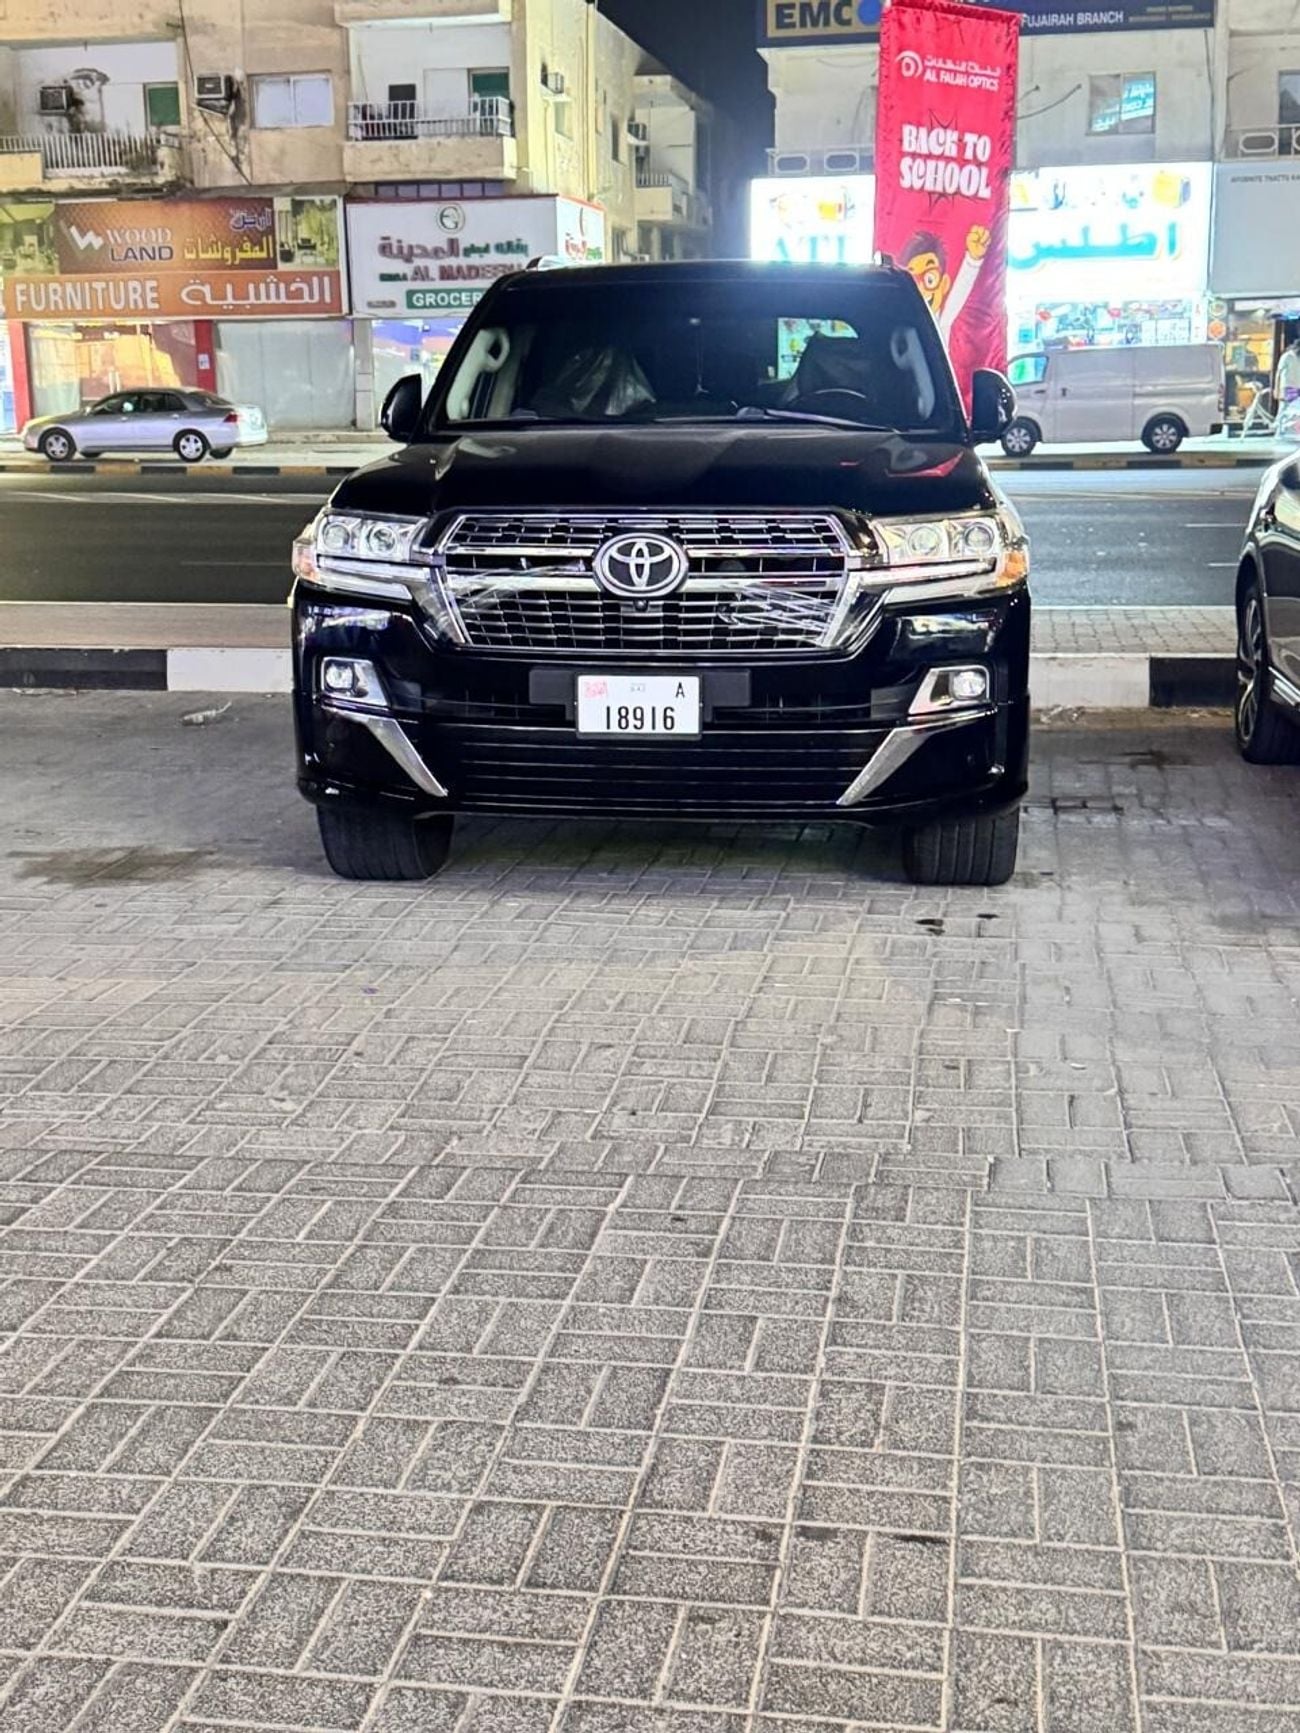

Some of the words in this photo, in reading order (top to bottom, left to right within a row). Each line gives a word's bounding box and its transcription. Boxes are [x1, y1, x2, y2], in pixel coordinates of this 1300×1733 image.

[1021, 13, 1074, 28] FUJAIRAH
[1076, 10, 1125, 26] BRANCH
[923, 67, 938, 83] AL
[939, 70, 968, 89] FALAH
[967, 74, 1001, 93] OPTICS
[901, 123, 960, 158] BACK
[962, 132, 992, 163] TO
[899, 156, 992, 200] SCHOOL
[106, 227, 173, 245] WOOD
[110, 245, 174, 263] LAND
[184, 234, 274, 265] المفروشات
[410, 264, 436, 281] AL
[15, 279, 160, 312] FURNITURE
[181, 275, 331, 310] الخشبية
[675, 681, 686, 699] A
[606, 705, 675, 731] 18916
